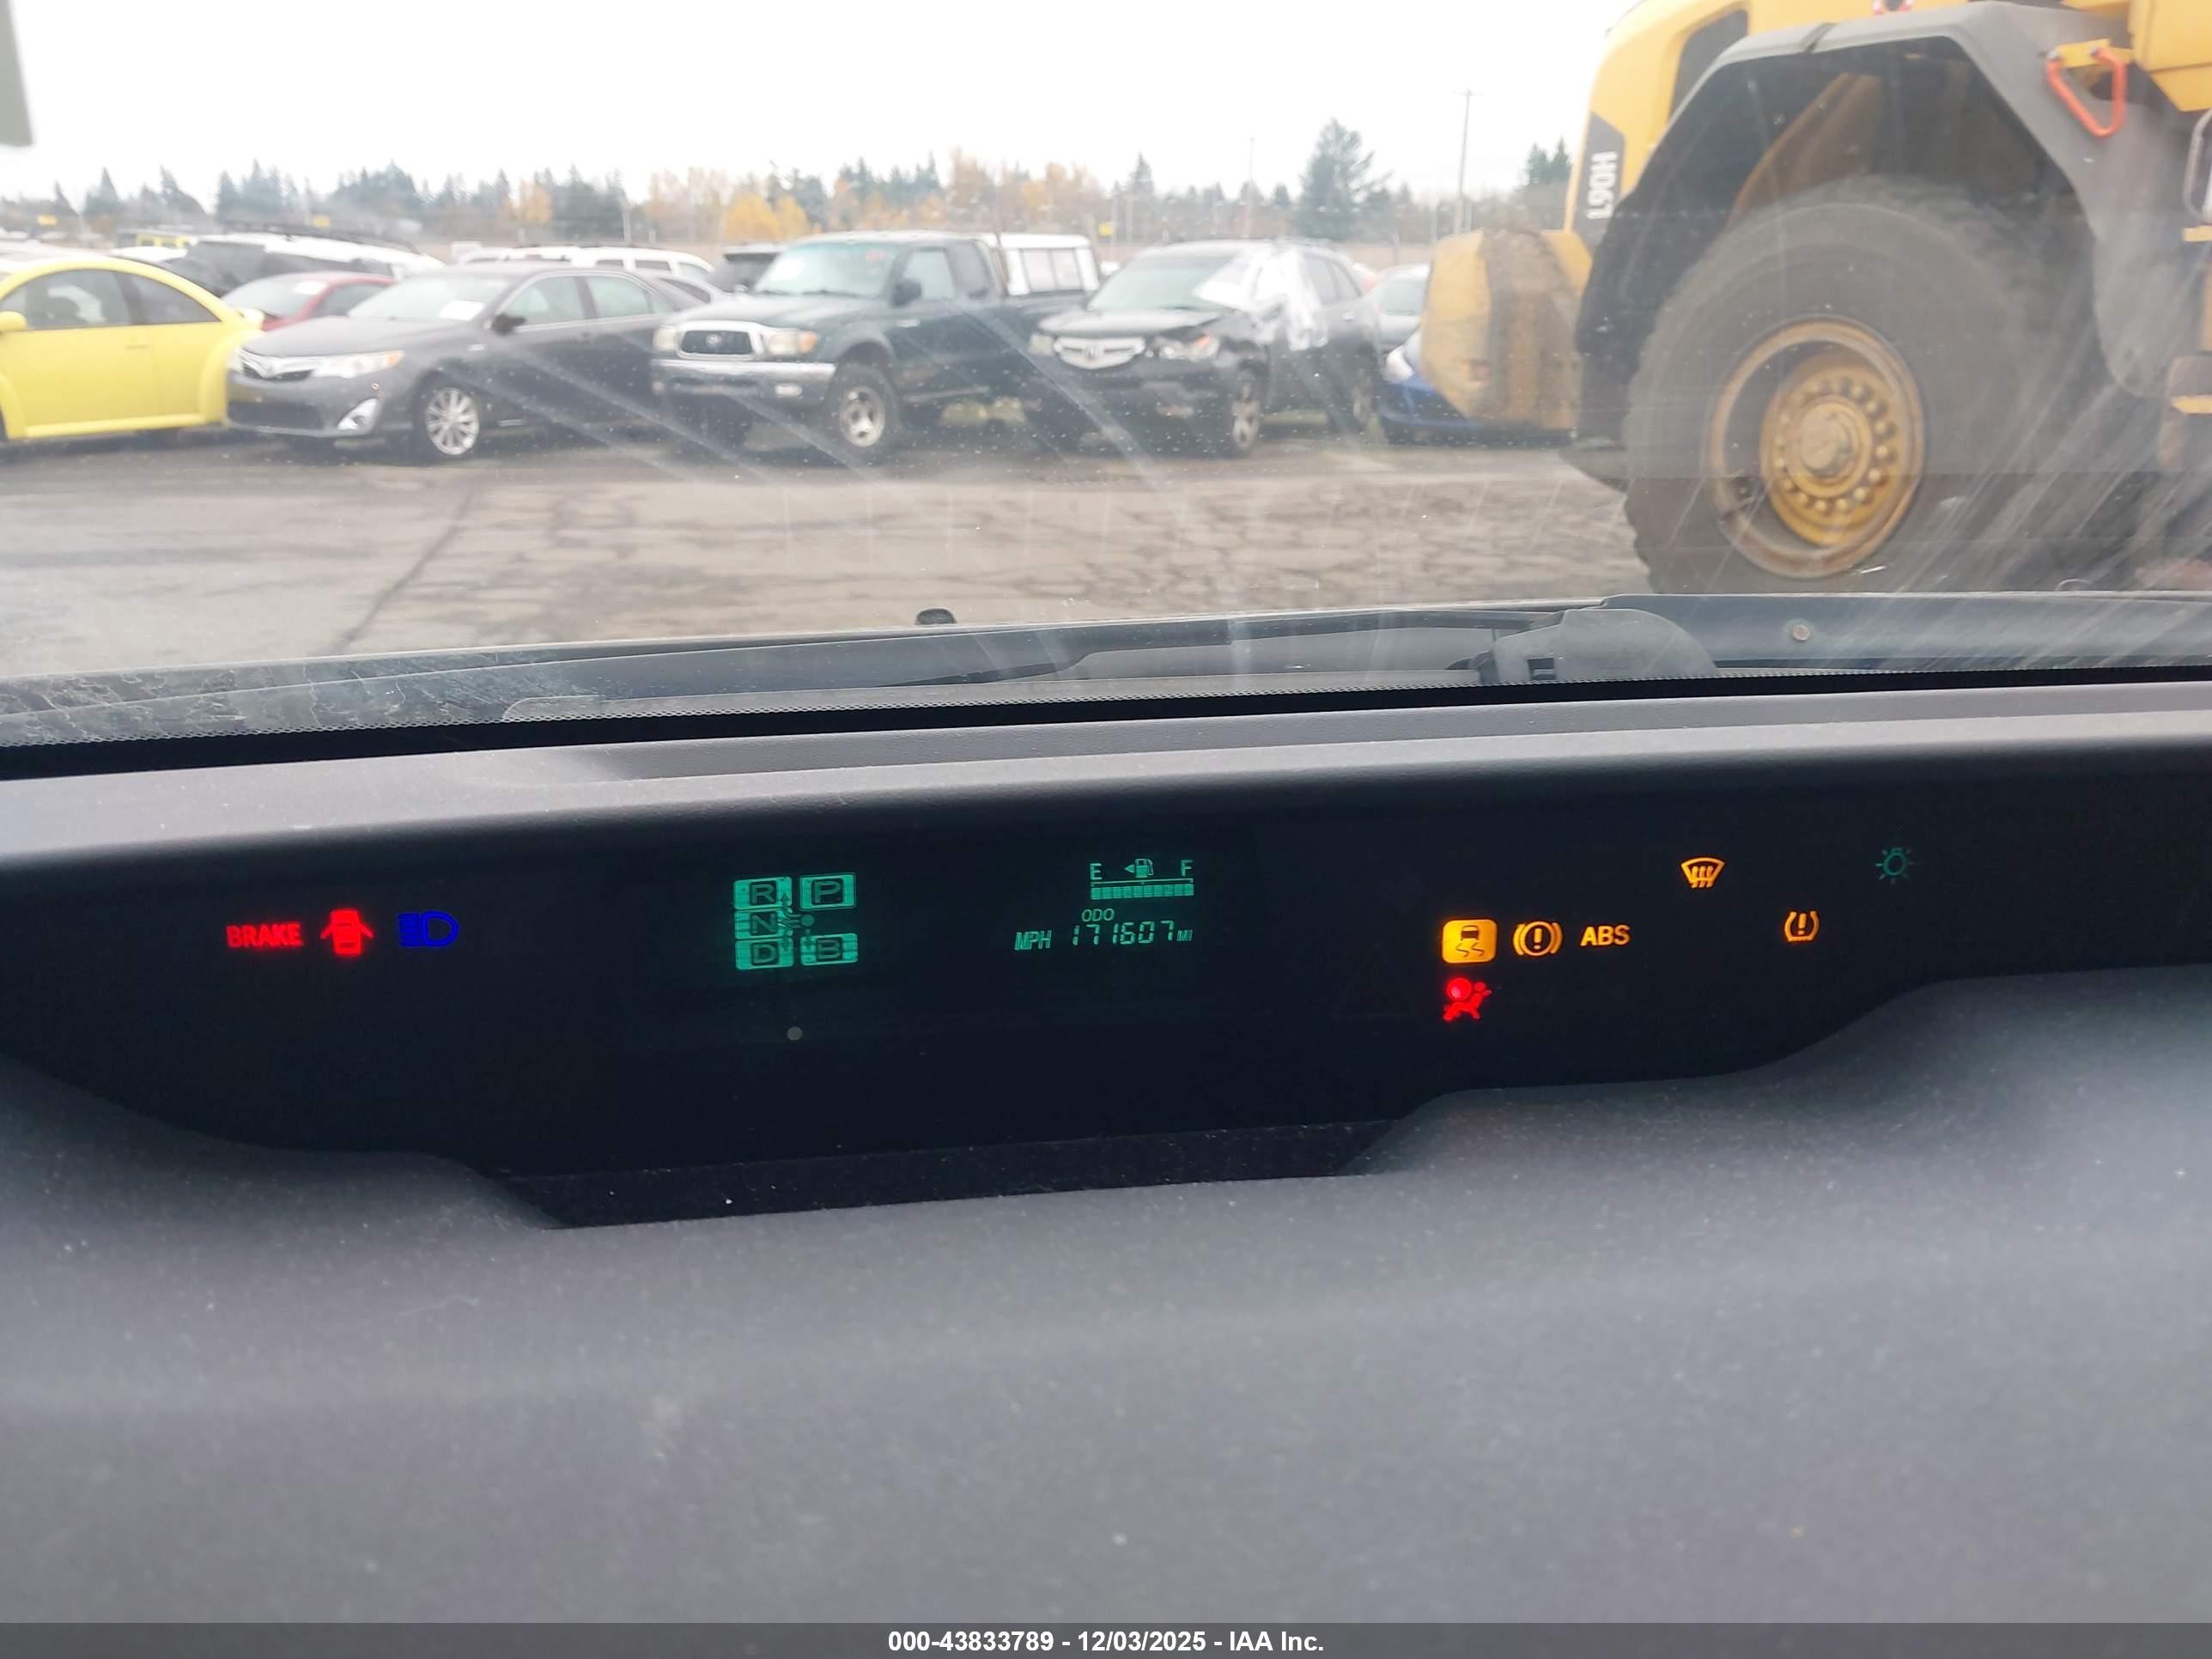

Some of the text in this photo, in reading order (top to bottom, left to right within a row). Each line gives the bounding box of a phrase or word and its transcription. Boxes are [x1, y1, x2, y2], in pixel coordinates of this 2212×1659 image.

[1586, 150, 1618, 219] L90H
[1090, 860, 1194, 880] E F
[751, 880, 842, 904] R P
[752, 913, 777, 934] N
[1081, 908, 1115, 922] ODO
[226, 922, 303, 949] BRAKE
[1014, 929, 1053, 951] MPH
[1073, 920, 1176, 946] 171607
[1580, 924, 1631, 947] ABS
[752, 939, 841, 964] D B
